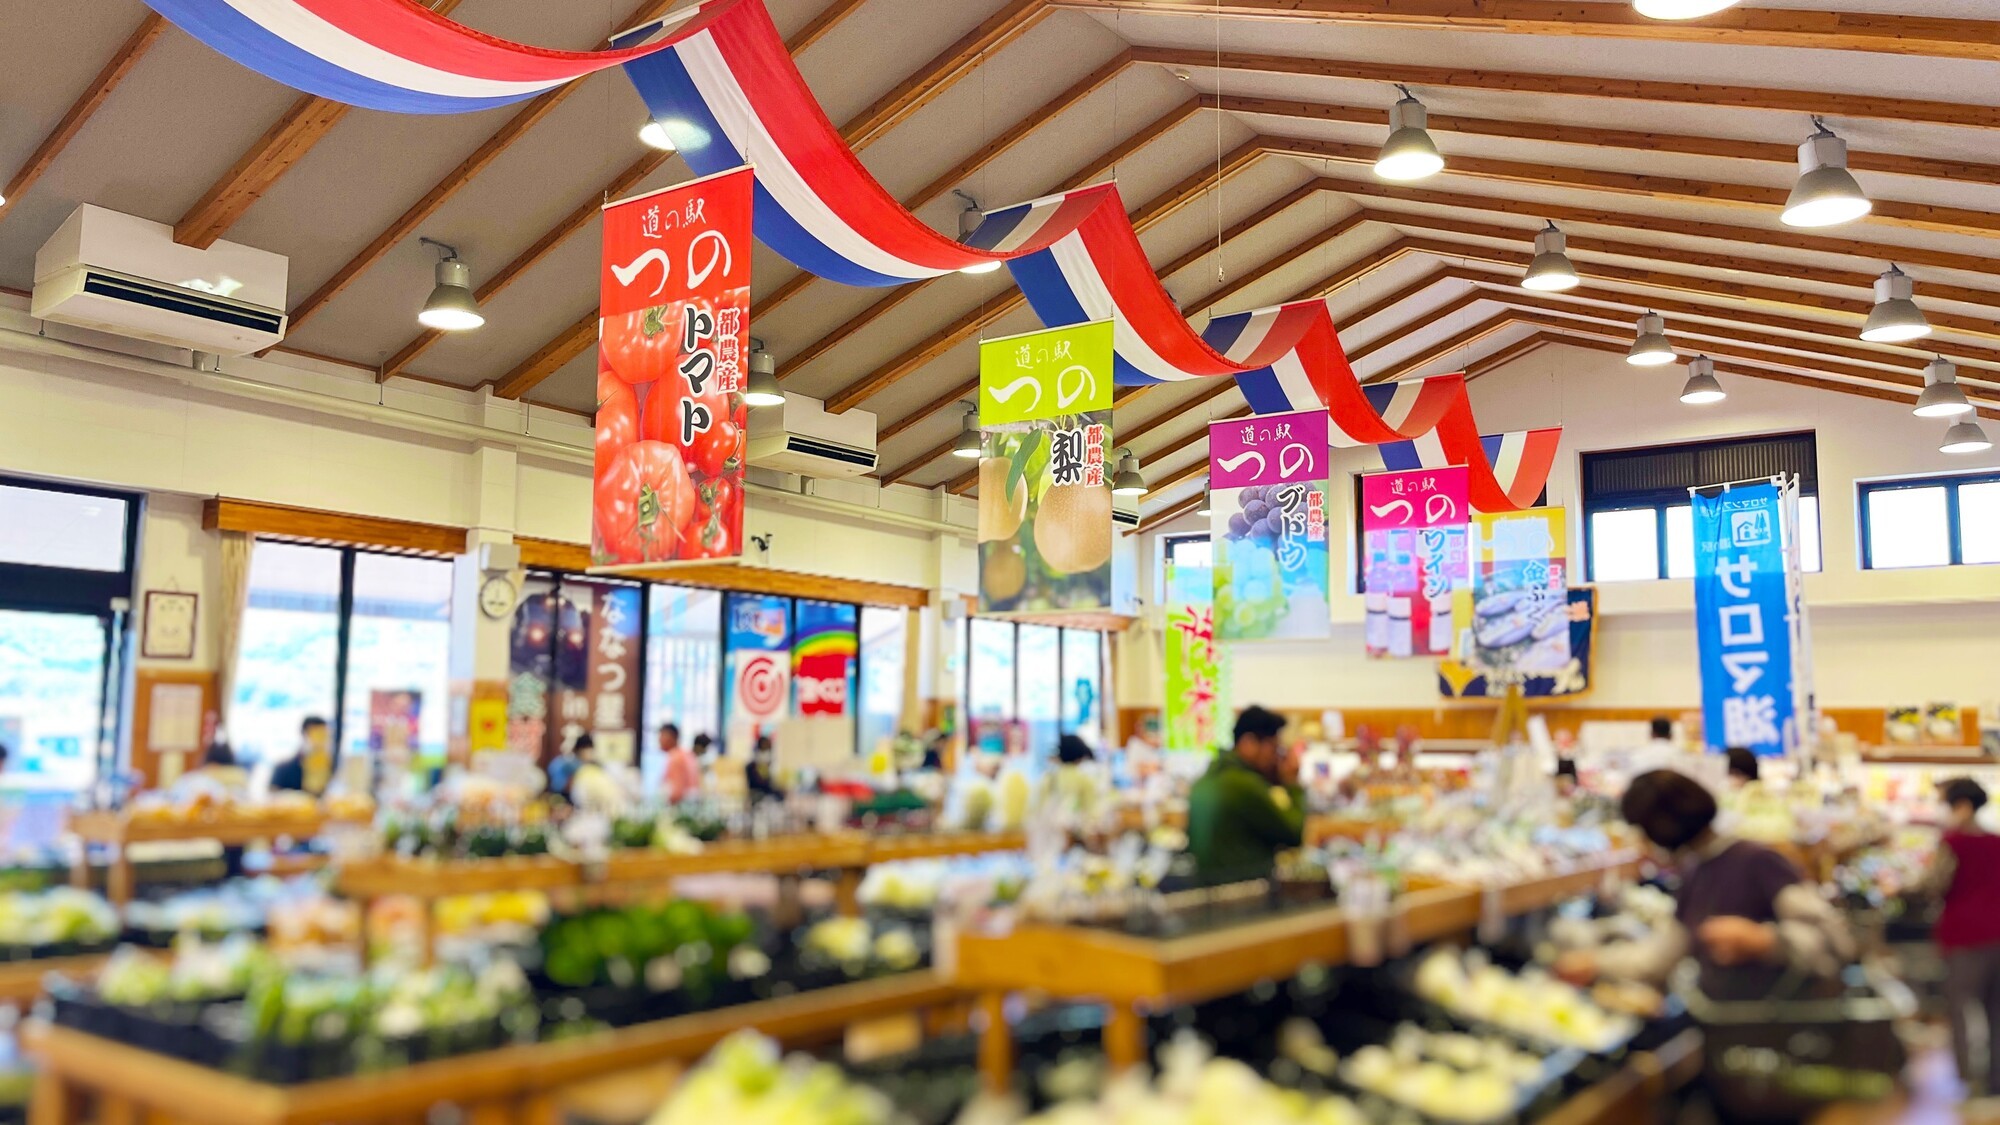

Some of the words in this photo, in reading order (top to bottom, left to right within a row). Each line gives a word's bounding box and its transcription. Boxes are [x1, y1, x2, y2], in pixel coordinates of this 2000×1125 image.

[642, 198, 707, 239] 道の駅
[611, 230, 732, 298] つの
[680, 306, 714, 445] トマト
[717, 309, 740, 393] 都農産
[1016, 340, 1073, 370] 道の駅
[988, 365, 1096, 414] つの
[1052, 431, 1083, 485] 梨
[1085, 424, 1104, 487] 都農産
[1240, 423, 1293, 446] 道の駅
[1217, 443, 1314, 481] つの
[1391, 478, 1437, 496] 道の駅
[1277, 485, 1307, 571] ブドウ
[1307, 491, 1324, 541] 都農産
[1370, 494, 1456, 524] つの
[1423, 529, 1448, 599] ワイン
